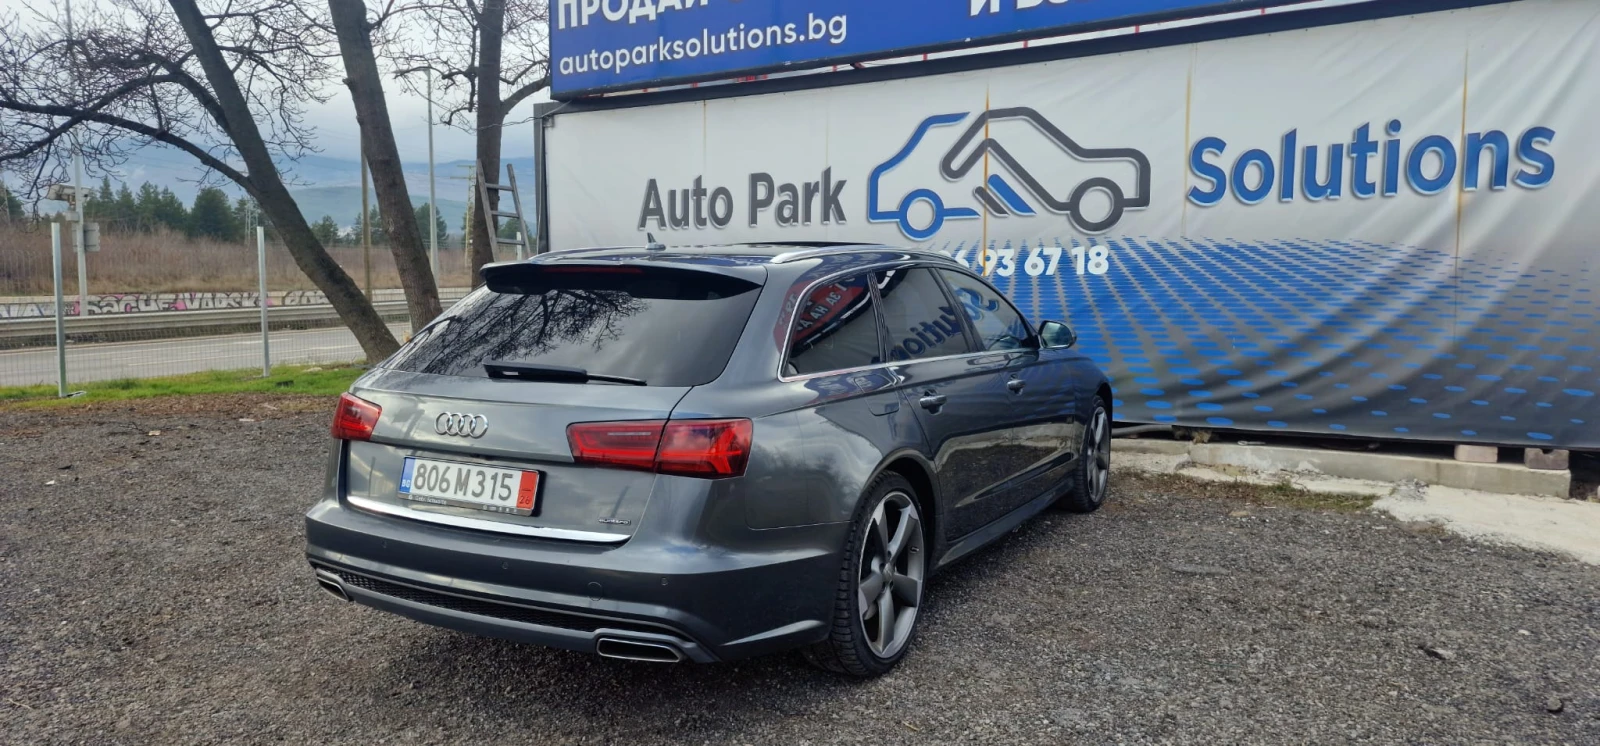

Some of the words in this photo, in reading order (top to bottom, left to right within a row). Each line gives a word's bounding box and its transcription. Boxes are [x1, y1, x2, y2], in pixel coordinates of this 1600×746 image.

[559, 13, 847, 75] autoparksolutions.bg
[638, 173, 734, 231] Auto
[748, 165, 848, 229] Park
[1187, 118, 1557, 207] Solutions
[978, 248, 1016, 277] 93
[1024, 246, 1063, 277] 67
[1071, 245, 1110, 275] 18
[401, 478, 411, 488] BG
[413, 463, 451, 493] 806
[453, 467, 471, 496] M
[472, 470, 513, 501] 315
[519, 495, 531, 505] 26
